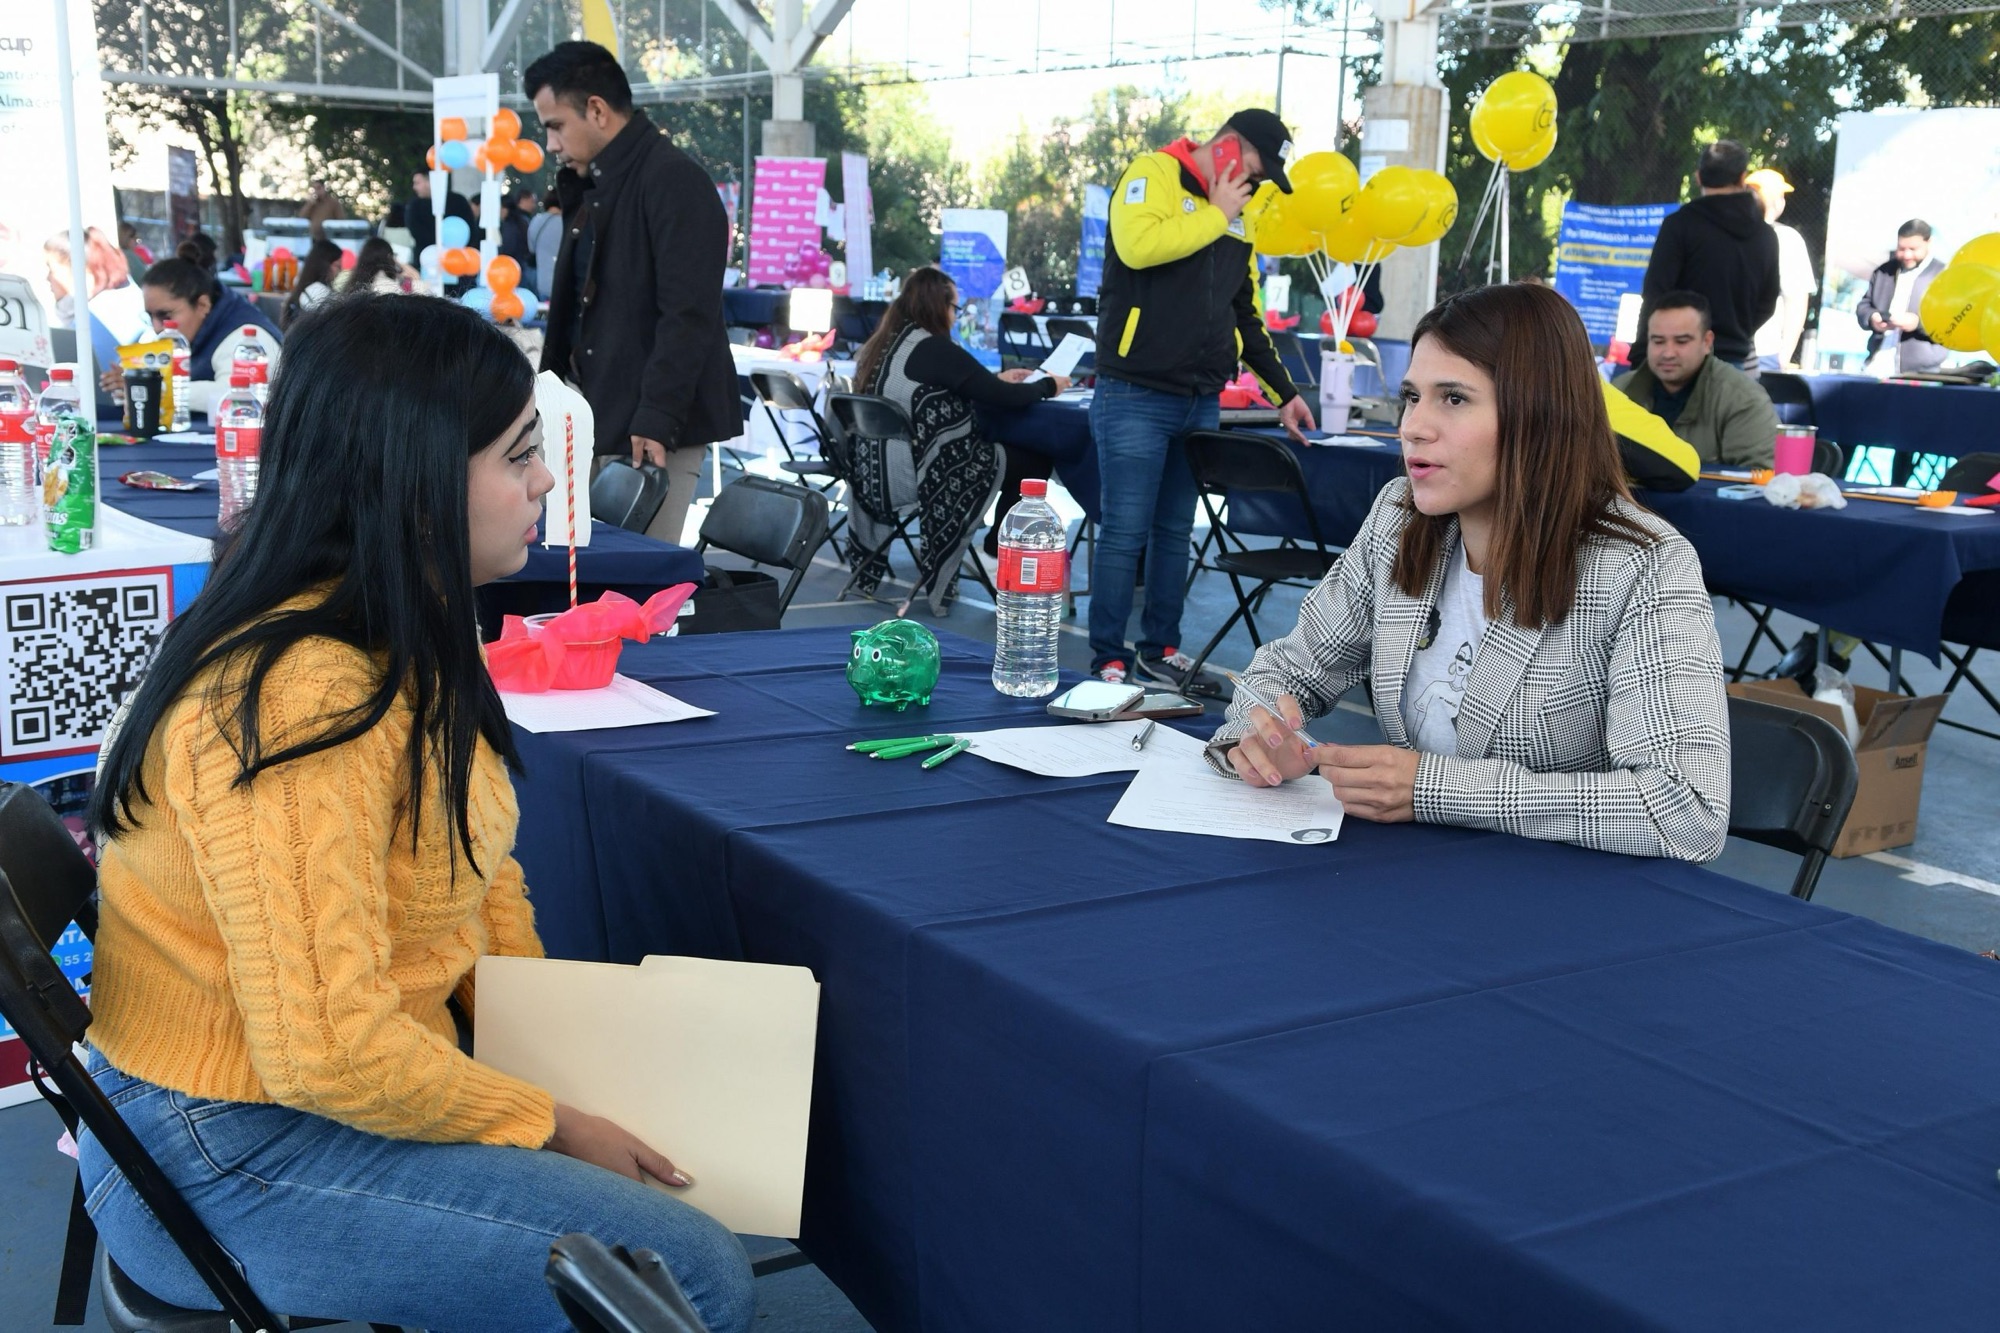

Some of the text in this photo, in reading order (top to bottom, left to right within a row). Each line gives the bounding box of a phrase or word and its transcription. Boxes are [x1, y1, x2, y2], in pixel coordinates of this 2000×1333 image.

[1009, 270, 1026, 291] 8
[1272, 286, 1283, 302] 7
[1944, 303, 1973, 336] sabro
[64, 956, 80, 966] 55
